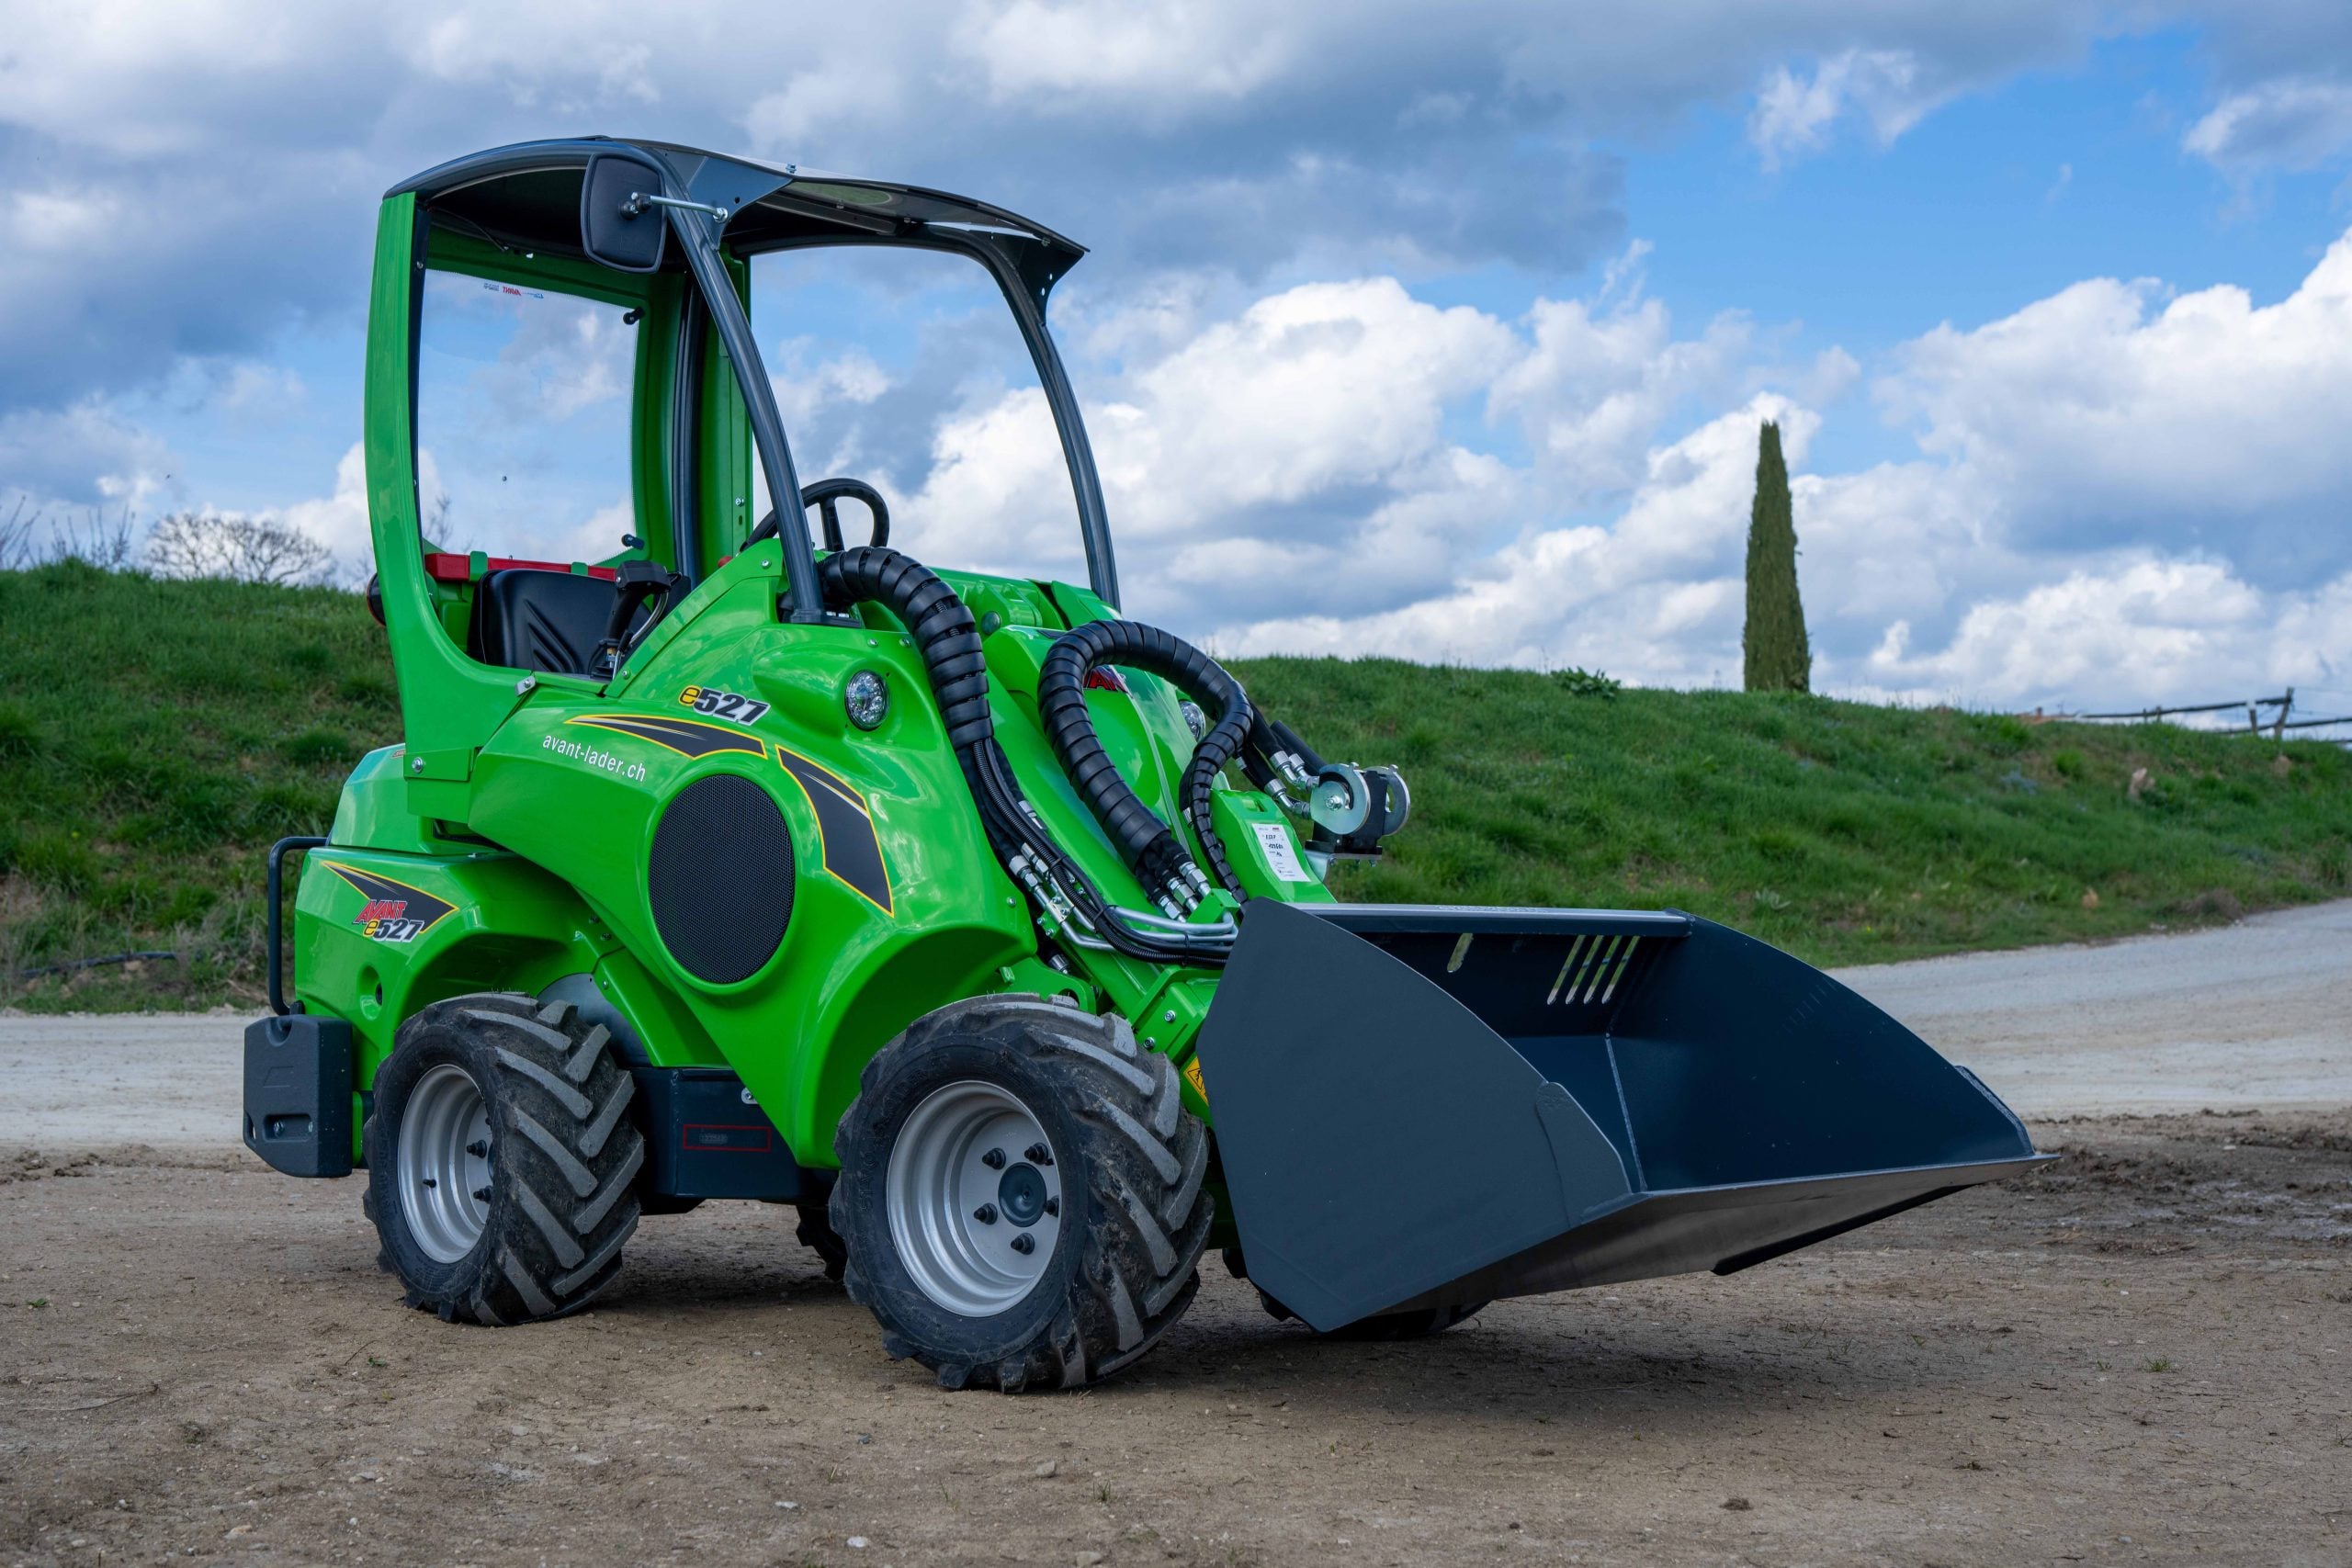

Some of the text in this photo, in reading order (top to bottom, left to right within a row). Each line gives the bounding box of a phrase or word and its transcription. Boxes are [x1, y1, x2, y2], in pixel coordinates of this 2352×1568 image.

[679, 686, 770, 726] e527
[542, 734, 647, 783] avant-lader.ch
[352, 899, 408, 925] AVANT
[363, 919, 425, 943] e527
